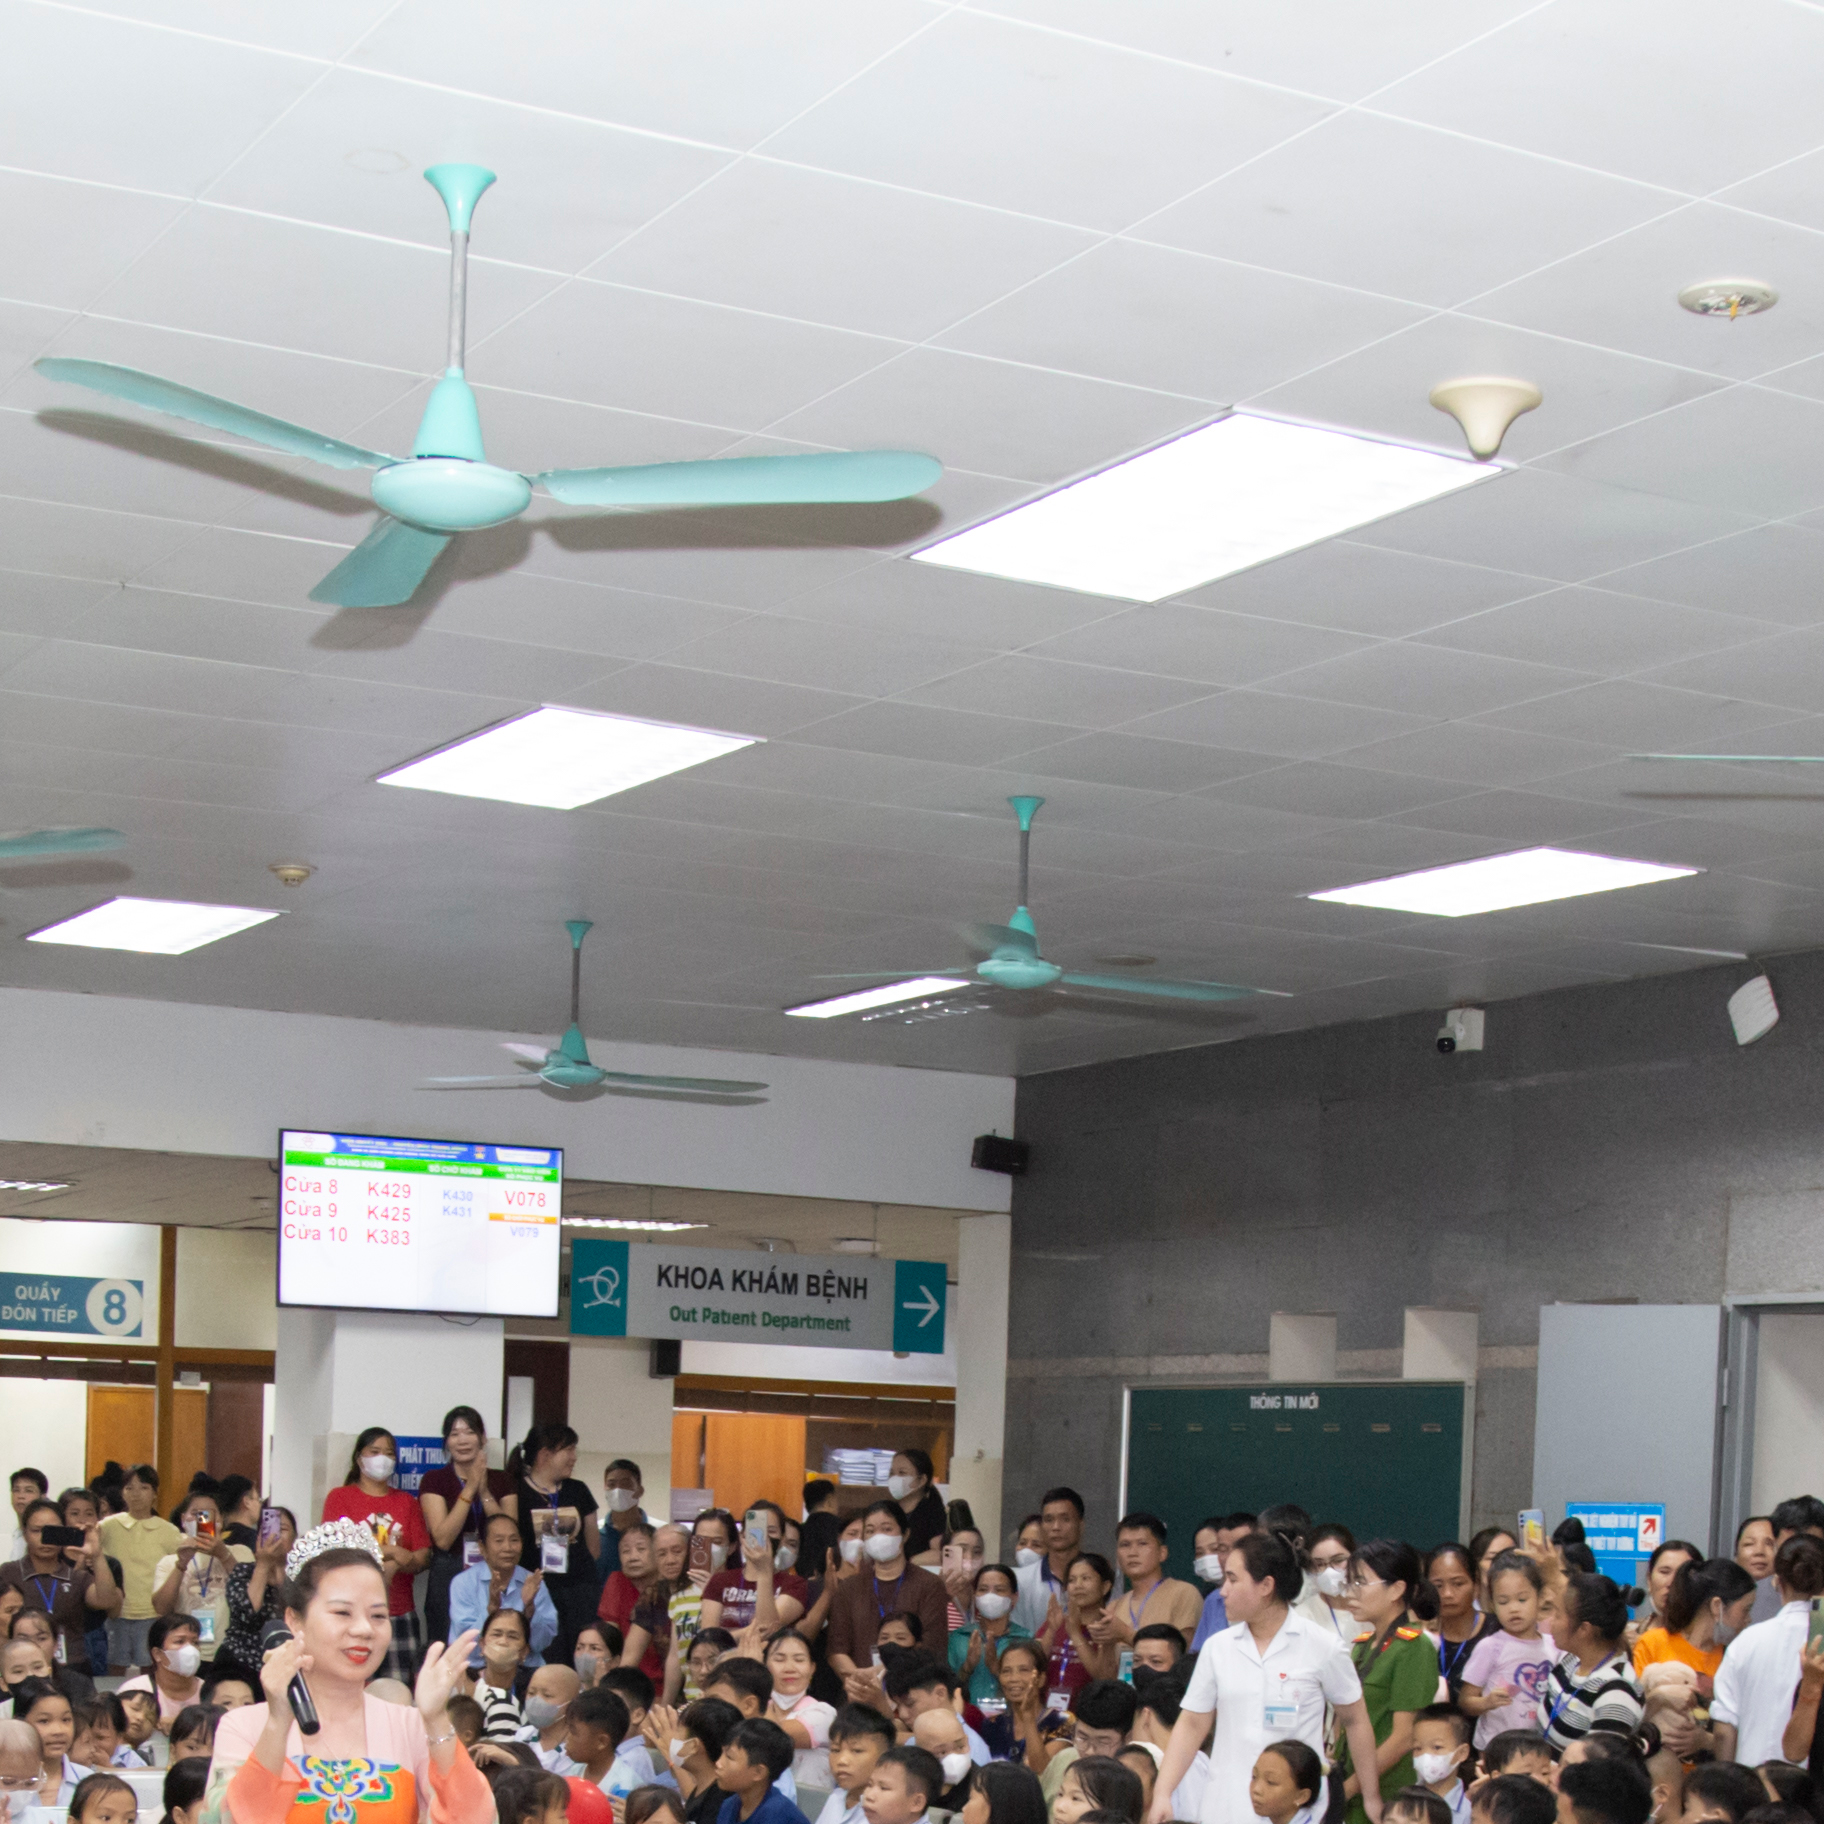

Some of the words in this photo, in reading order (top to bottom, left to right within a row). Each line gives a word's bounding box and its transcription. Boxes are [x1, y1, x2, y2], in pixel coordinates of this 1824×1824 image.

[329, 1179, 339, 1195] 8
[368, 1181, 412, 1199] K429
[442, 1189, 474, 1202] K430
[505, 1190, 547, 1208] V078
[328, 1202, 338, 1218] 9
[367, 1205, 412, 1222] K425
[442, 1205, 473, 1218] K431
[329, 1226, 348, 1242] 10
[366, 1228, 411, 1246] K383
[657, 1263, 724, 1291] KHOA
[732, 1265, 799, 1296] KHÁM
[807, 1270, 868, 1303] BỆNH
[1, 1305, 37, 1321] ĐÓN
[43, 1303, 78, 1324] TIẾP
[101, 1288, 128, 1326] 8
[669, 1305, 697, 1323] Out
[702, 1307, 756, 1327] Patient
[761, 1310, 851, 1332] Department
[1249, 1392, 1281, 1410] THÔNG
[1283, 1395, 1298, 1409] TIN
[1298, 1391, 1320, 1410] MỚI
